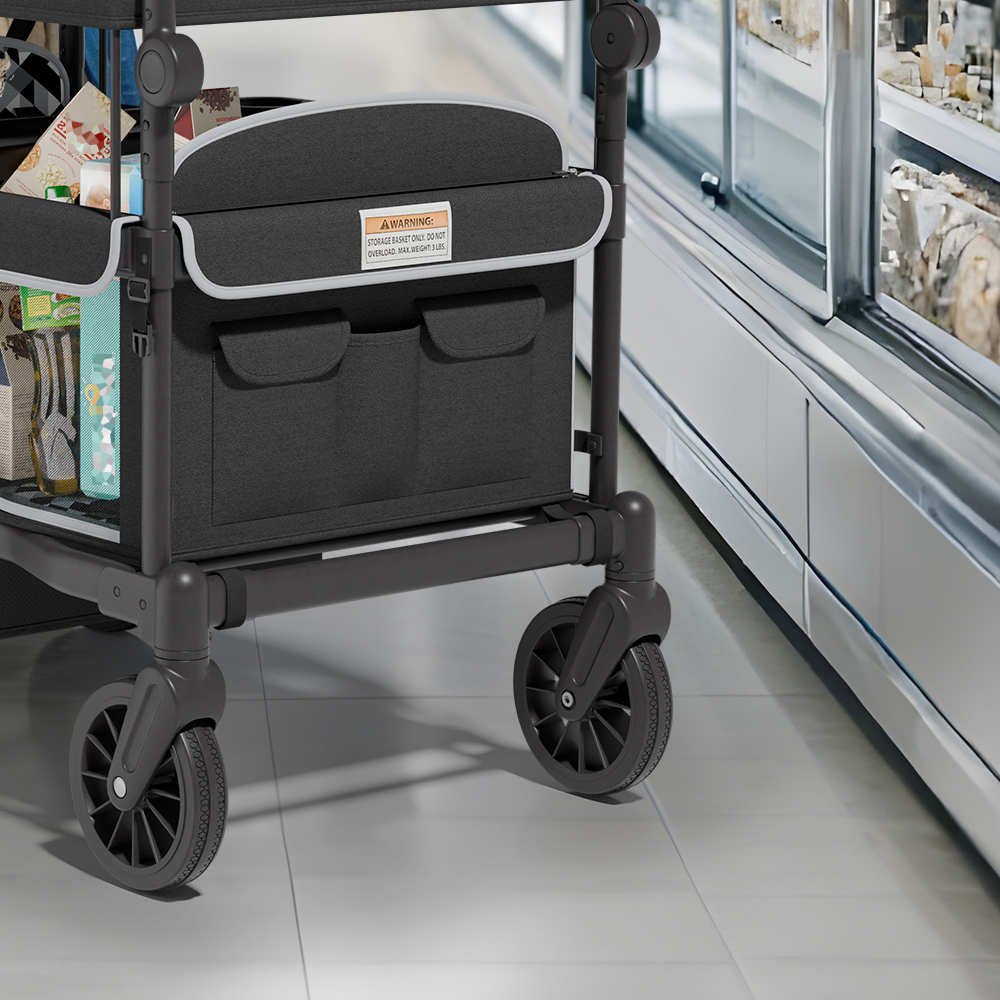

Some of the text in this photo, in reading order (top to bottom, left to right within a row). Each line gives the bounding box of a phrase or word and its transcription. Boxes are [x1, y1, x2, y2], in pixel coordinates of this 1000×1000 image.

[390, 217, 433, 229] WARNING:
[368, 231, 445, 246] STORAGE BASKET ONLY. DO NOT
[368, 248, 396, 257] OVERLOAD.
[411, 244, 431, 253] WEIGHT:
[436, 243, 446, 251] LBS.
